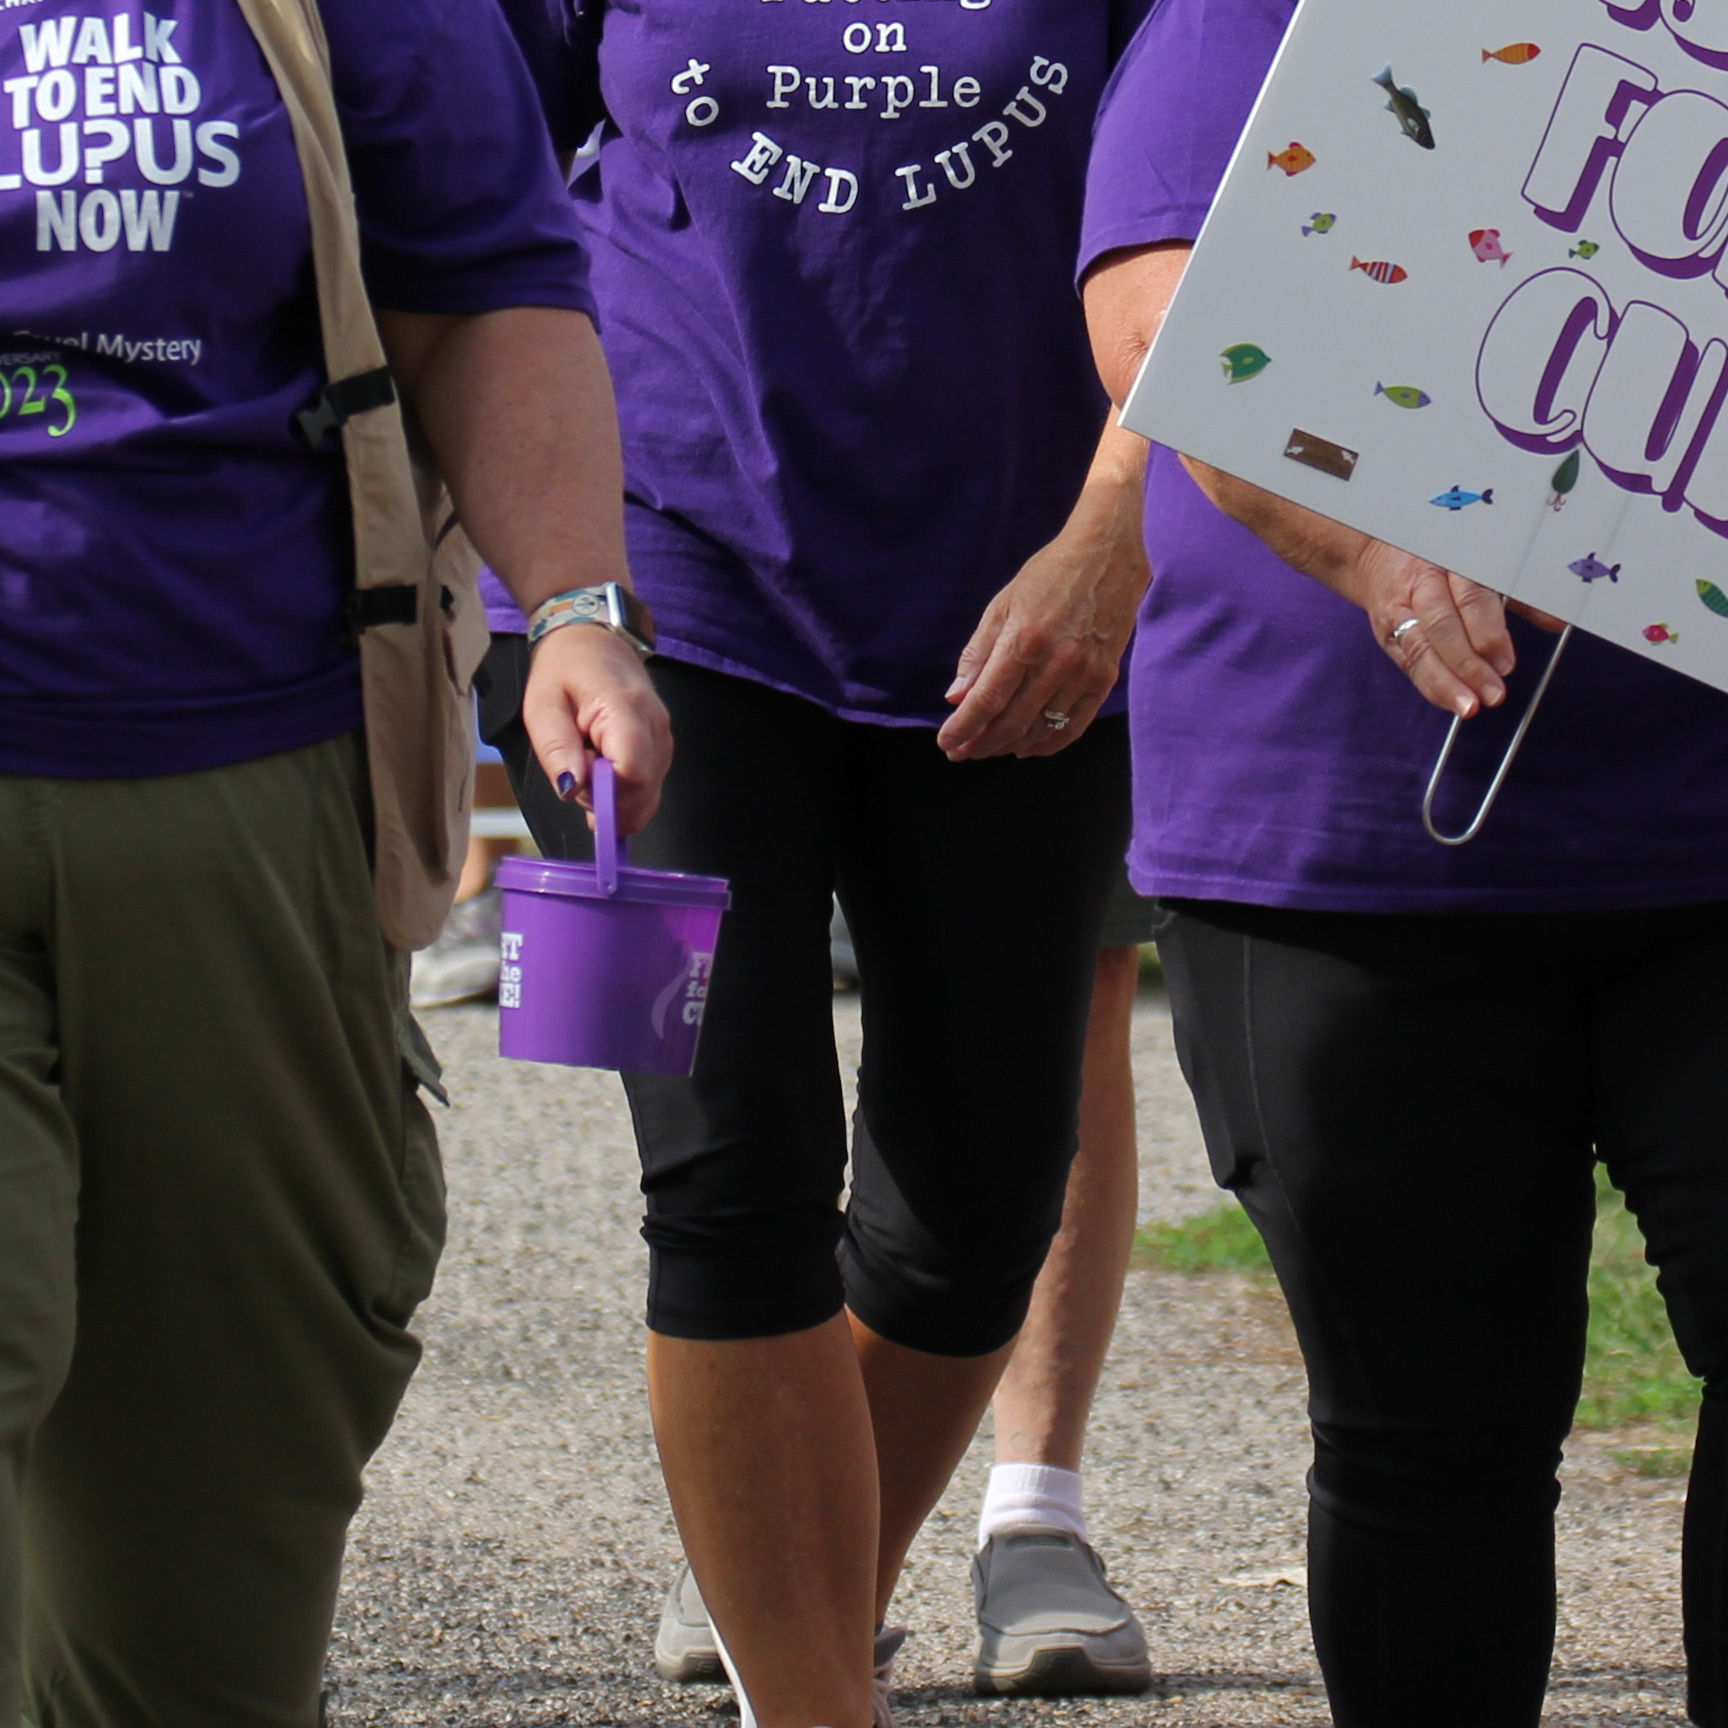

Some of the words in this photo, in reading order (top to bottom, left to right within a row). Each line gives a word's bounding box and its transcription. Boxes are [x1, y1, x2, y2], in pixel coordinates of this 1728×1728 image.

[18, 11, 182, 74] WALK
[842, 21, 908, 54] on
[3, 73, 77, 130] TO
[84, 62, 202, 118] END
[766, 64, 982, 120] Purple
[671, 59, 720, 127] to
[730, 131, 860, 215] END
[895, 55, 1069, 211] LUPUS
[36, 189, 181, 253] NOW
[95, 332, 203, 367] Mystery
